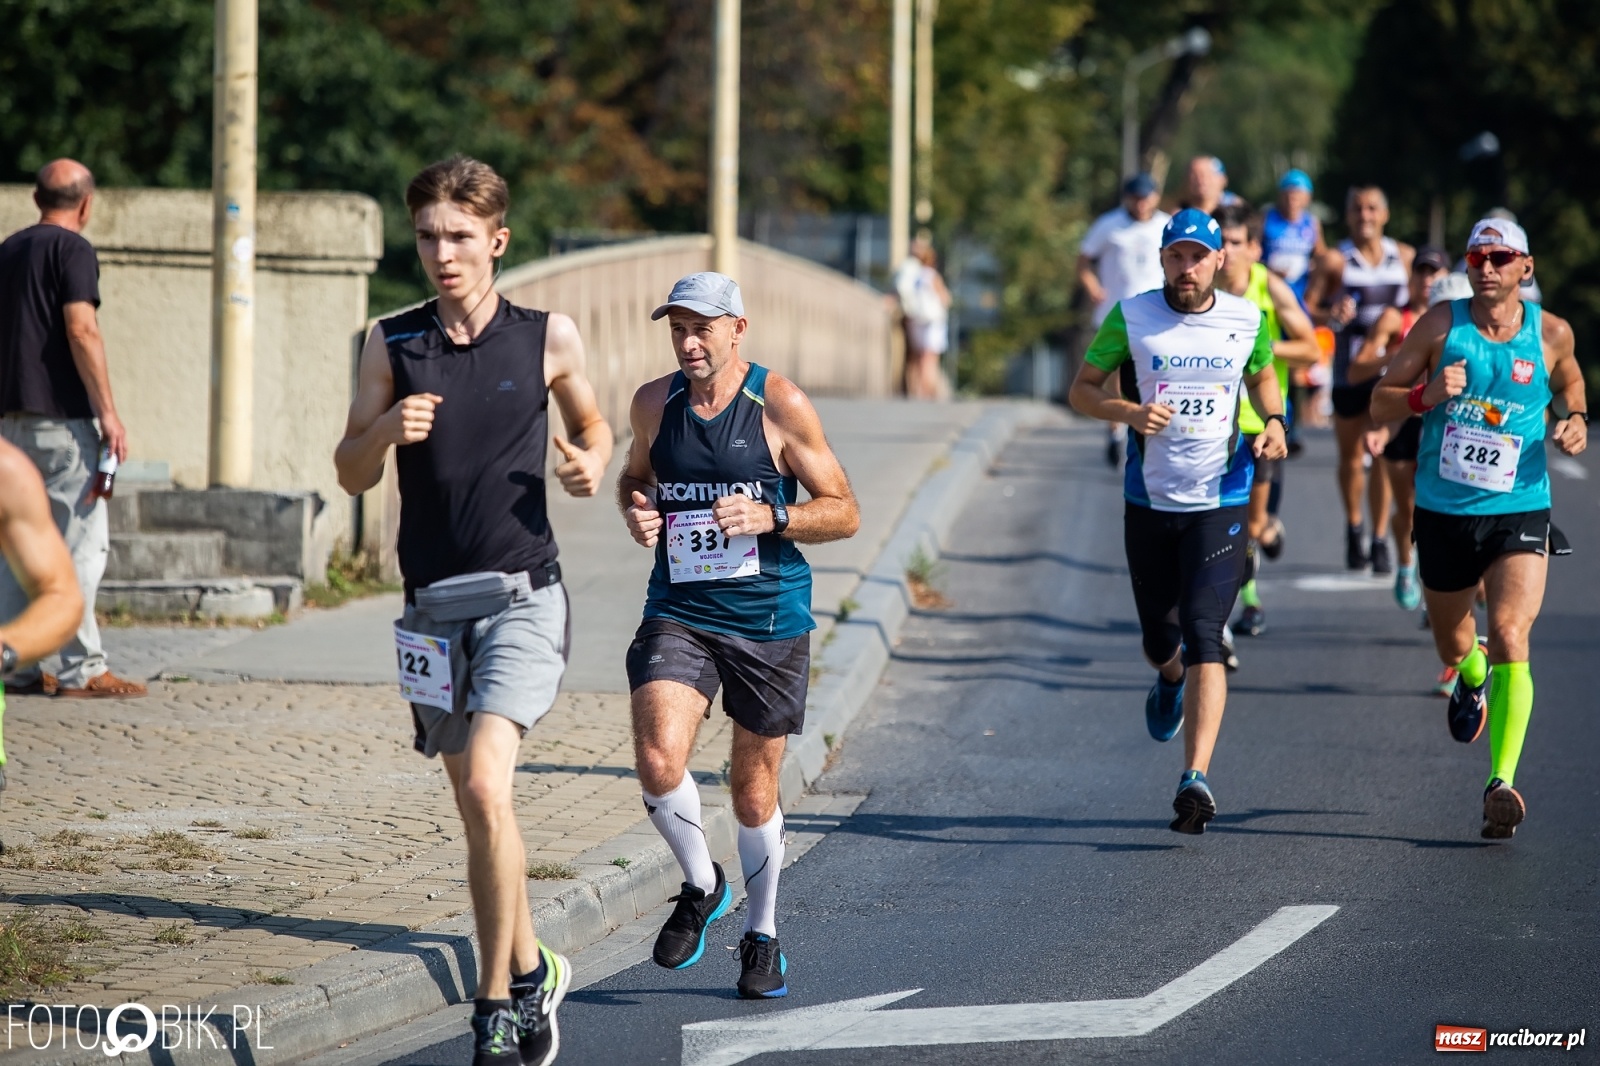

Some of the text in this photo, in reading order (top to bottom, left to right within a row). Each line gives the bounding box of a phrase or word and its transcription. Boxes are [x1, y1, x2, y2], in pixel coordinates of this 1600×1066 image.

[1179, 399, 1215, 416] 235
[1463, 445, 1501, 467] 282
[658, 481, 763, 502] DECATHLON
[699, 552, 724, 560] WOJCIECH
